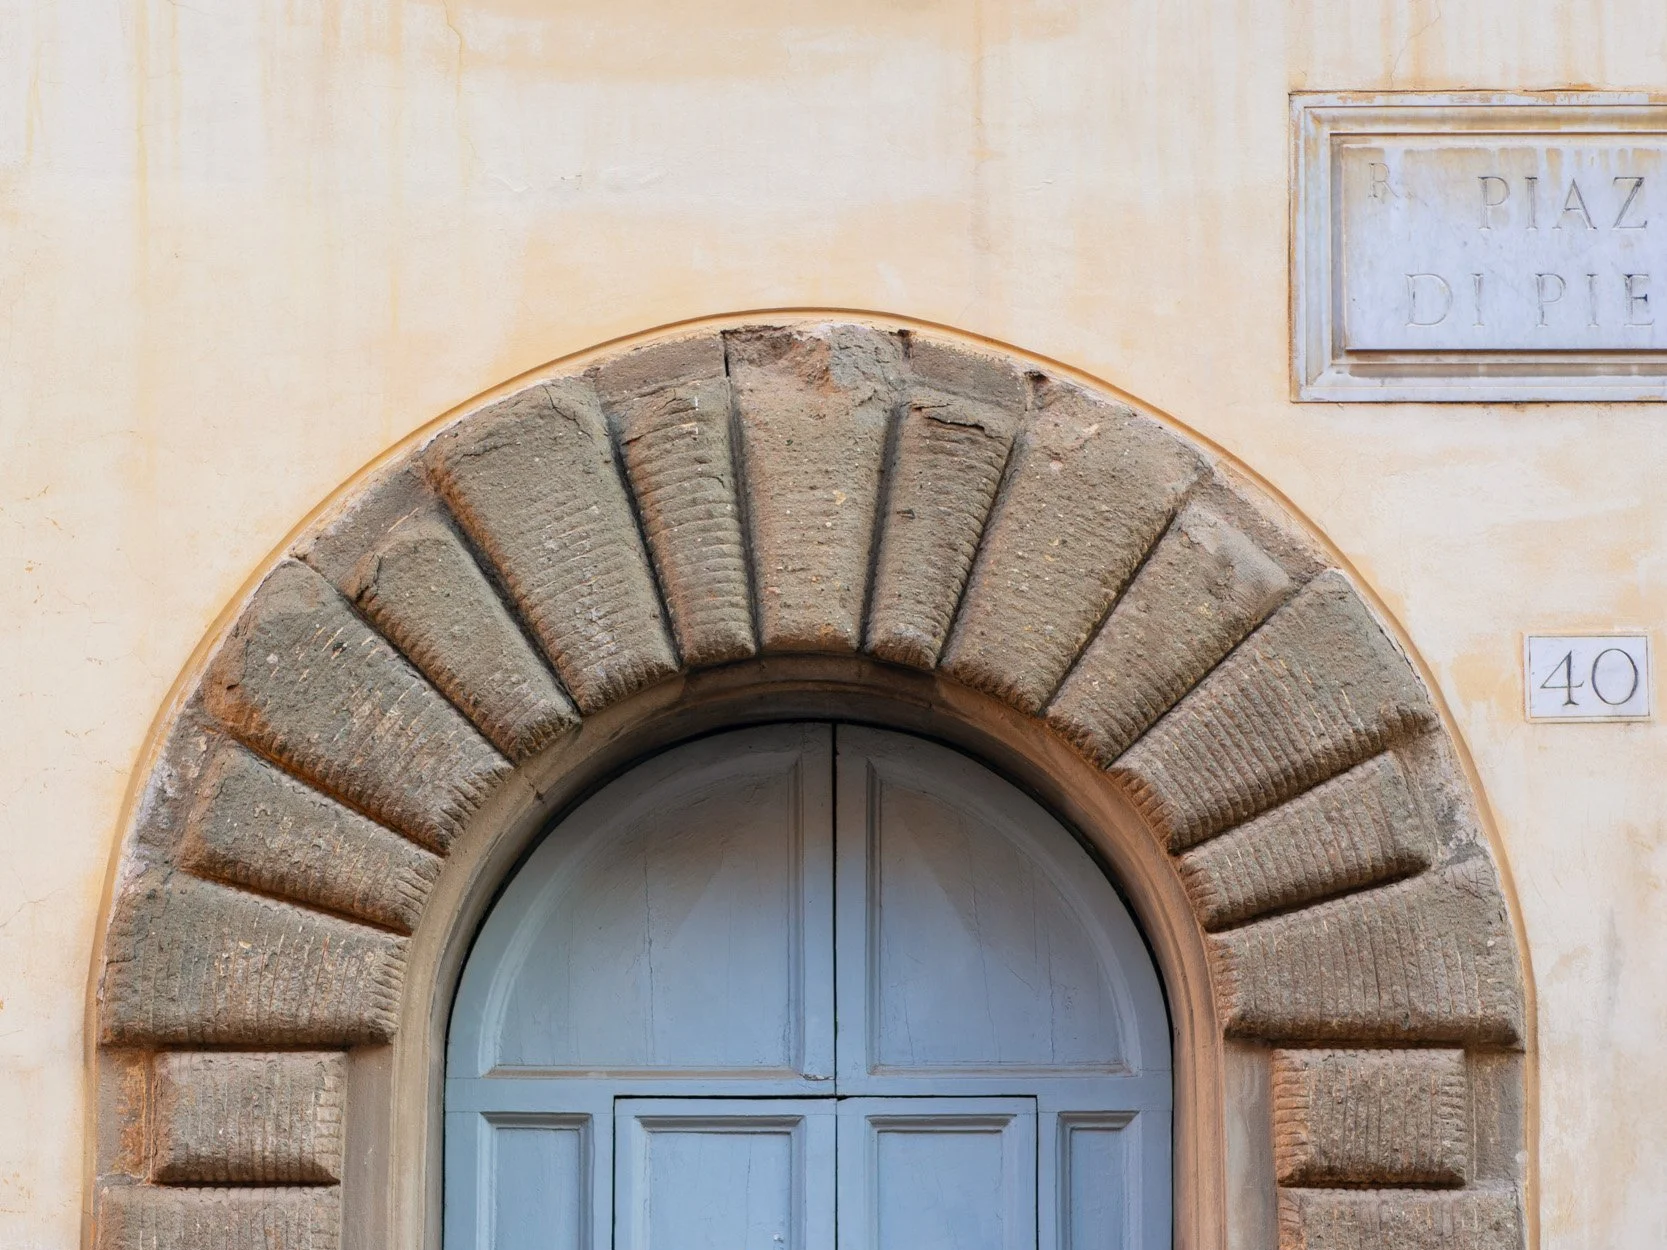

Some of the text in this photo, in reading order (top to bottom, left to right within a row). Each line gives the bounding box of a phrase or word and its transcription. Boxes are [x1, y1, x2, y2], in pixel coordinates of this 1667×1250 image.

[1404, 272, 1656, 328] DI PIE
[1539, 648, 1639, 707] 40
